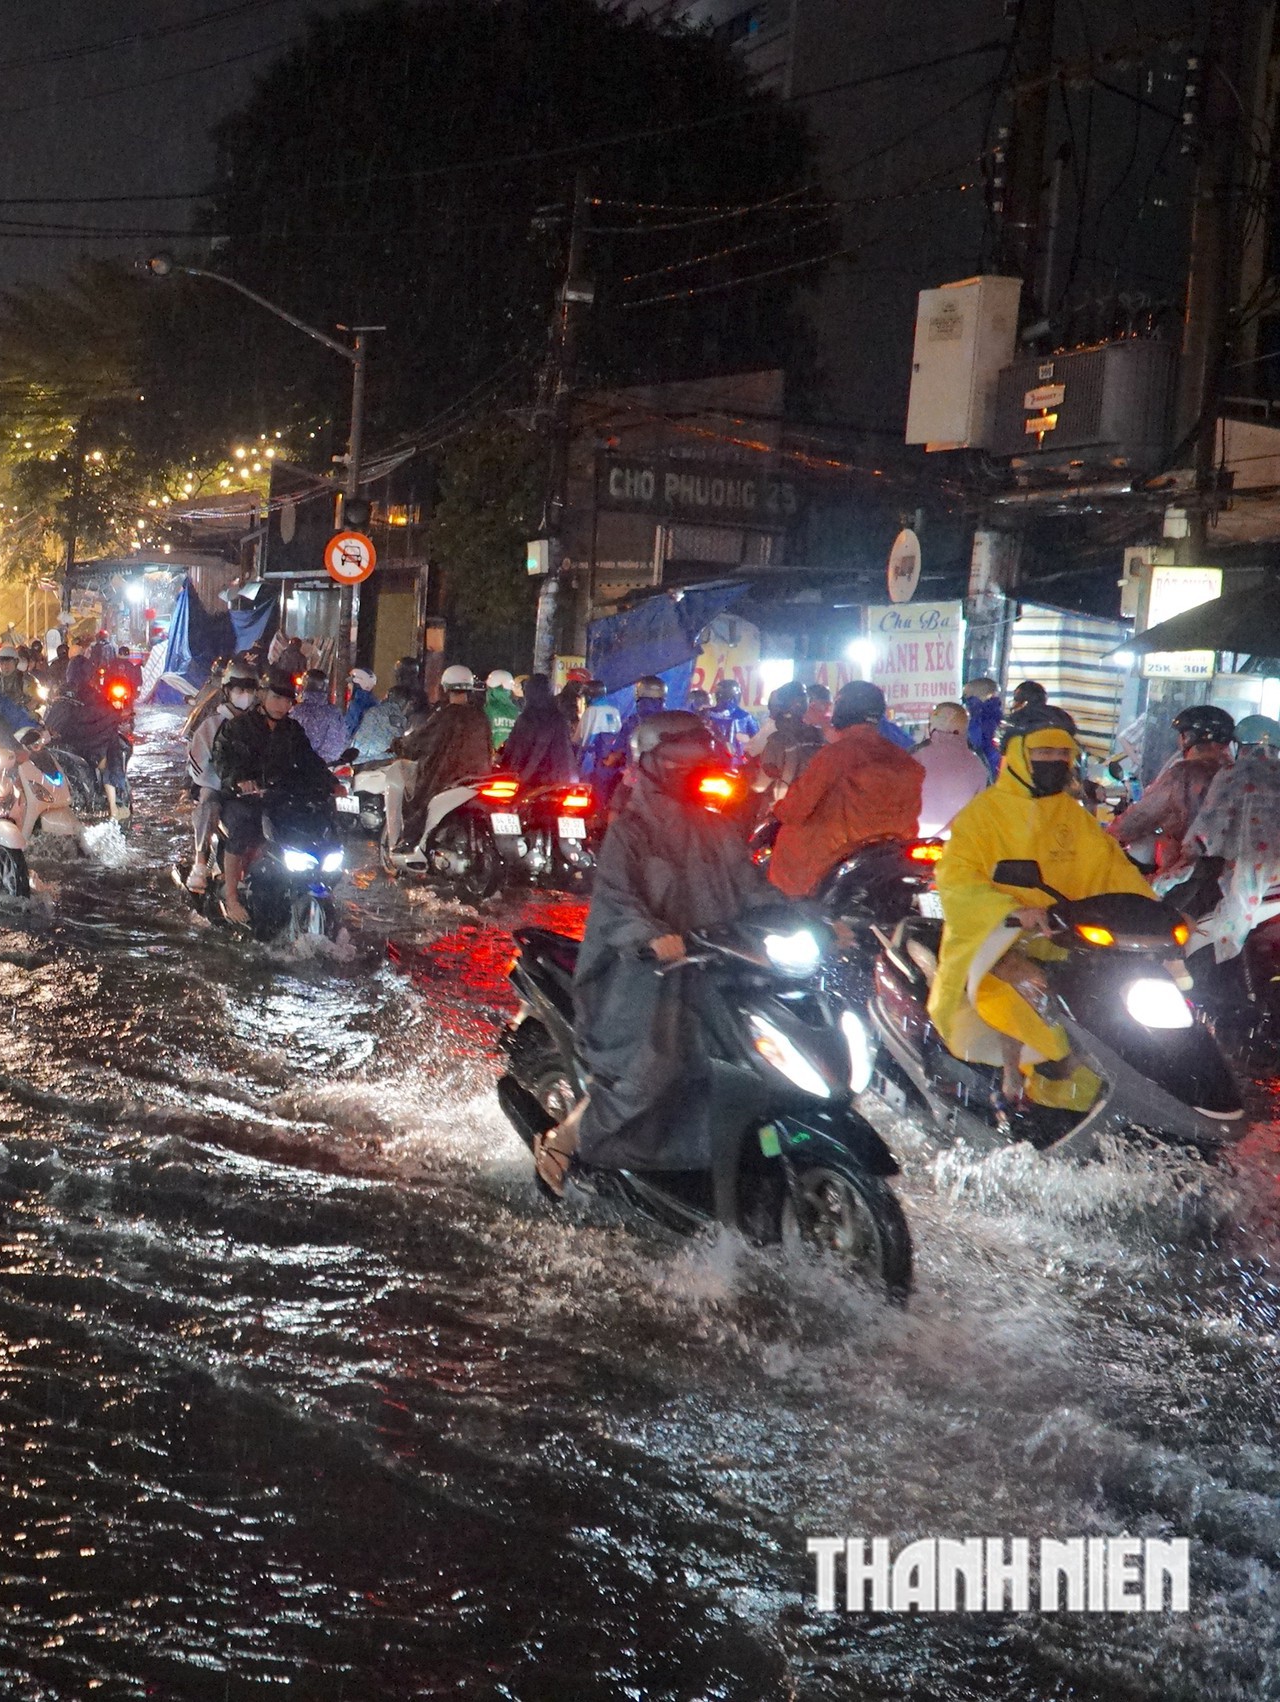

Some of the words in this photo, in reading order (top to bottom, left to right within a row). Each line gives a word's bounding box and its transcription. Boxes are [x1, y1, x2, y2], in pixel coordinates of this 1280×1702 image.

[1147, 663, 1171, 673] 25K
[1183, 664, 1208, 673] 30K
[914, 681, 957, 697] TRUNG
